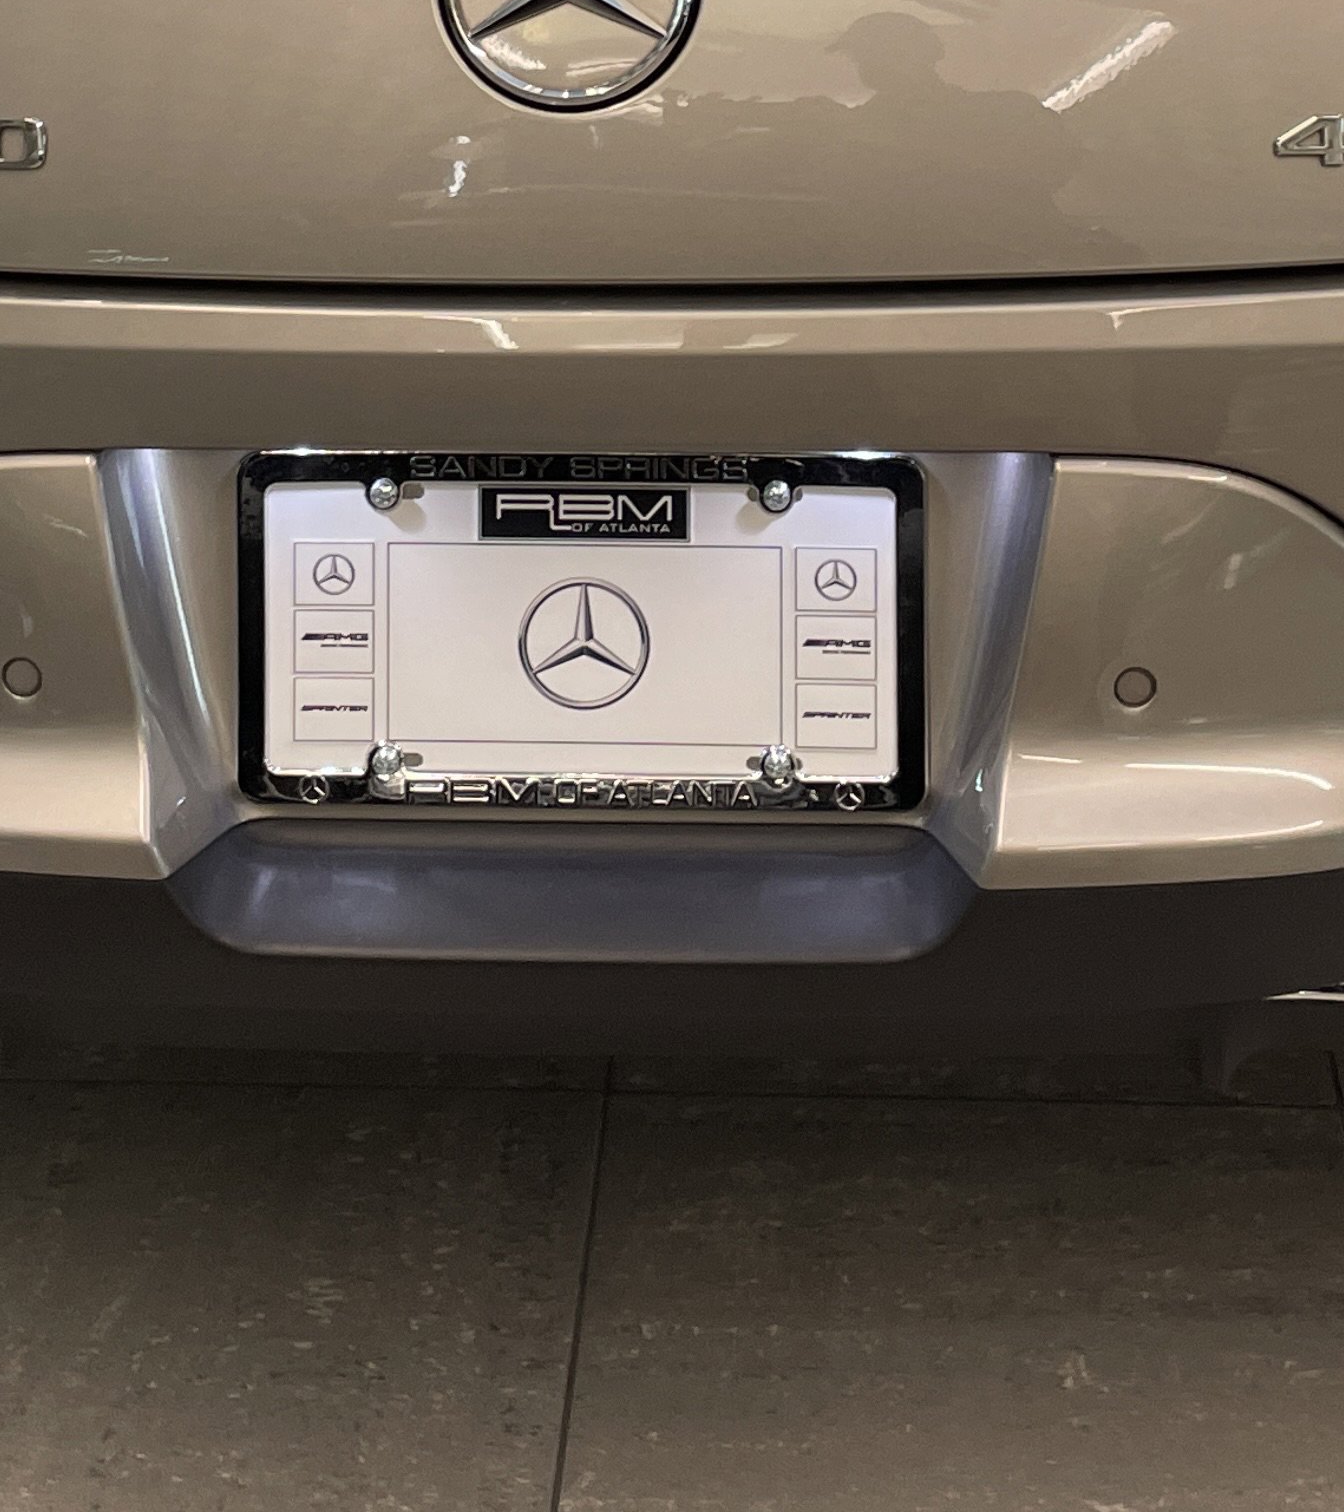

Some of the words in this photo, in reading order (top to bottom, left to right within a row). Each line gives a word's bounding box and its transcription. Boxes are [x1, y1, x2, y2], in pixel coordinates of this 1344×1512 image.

[409, 454, 554, 480] SANDY
[570, 455, 749, 481] SPRINGS
[496, 494, 674, 530] RBM
[571, 522, 593, 534] OF
[599, 522, 672, 535] ATLANTA
[405, 777, 541, 806] RBM
